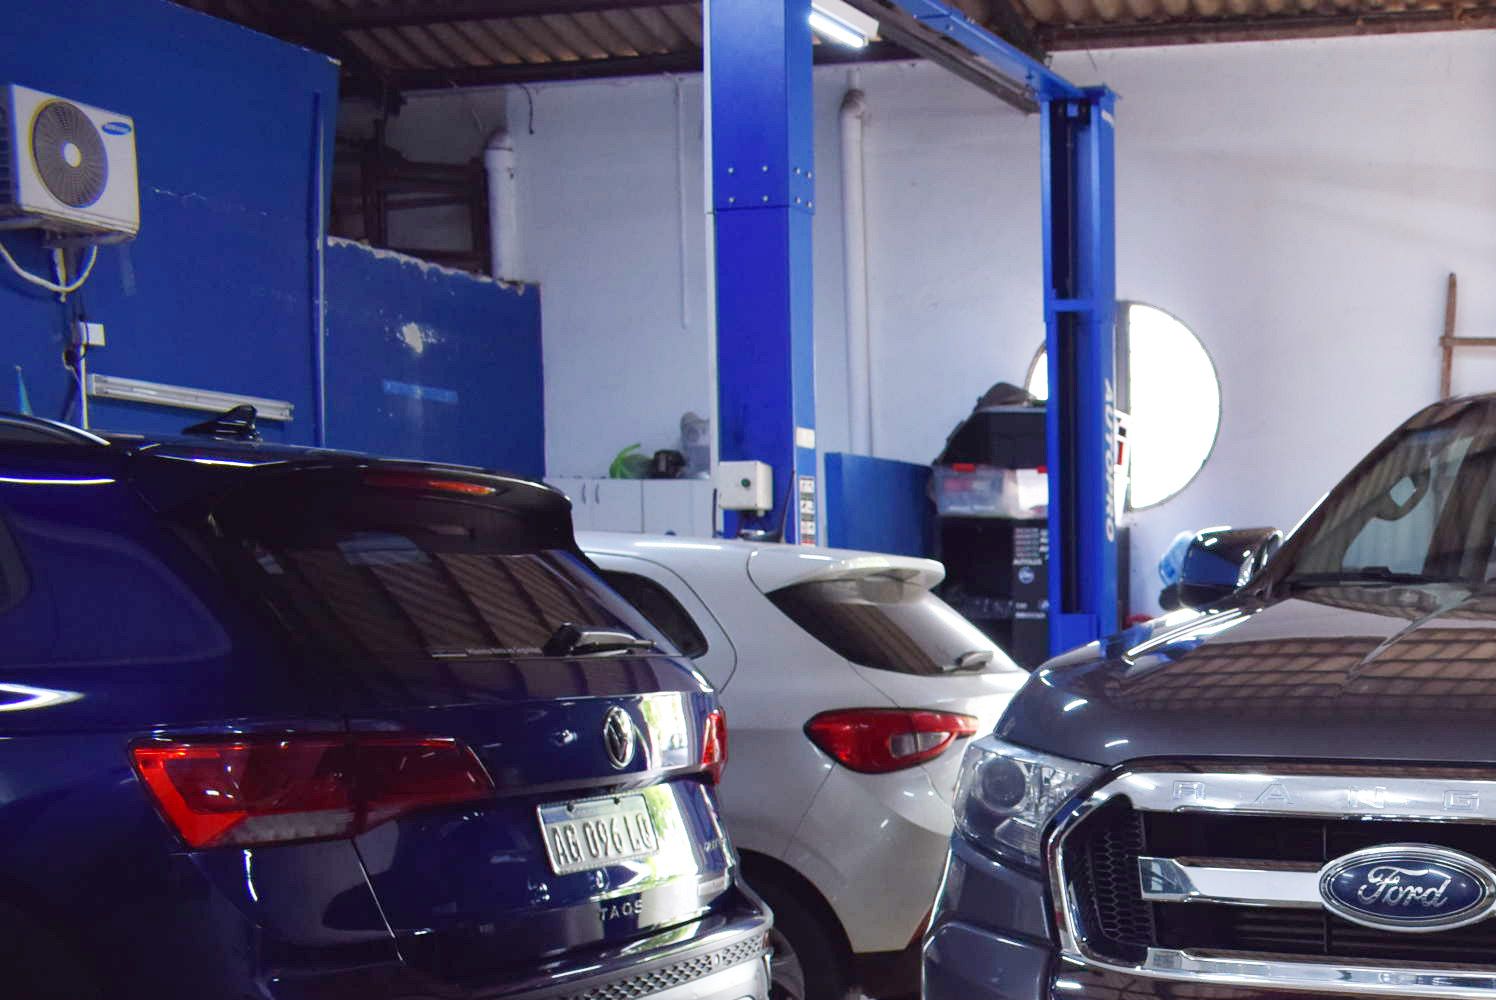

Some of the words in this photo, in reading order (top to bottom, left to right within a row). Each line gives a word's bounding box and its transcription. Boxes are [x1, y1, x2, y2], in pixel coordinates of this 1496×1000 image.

[551, 823, 585, 866] AG
[583, 817, 624, 859] 096
[1357, 865, 1452, 907] Ford
[600, 898, 645, 921] TAOS
